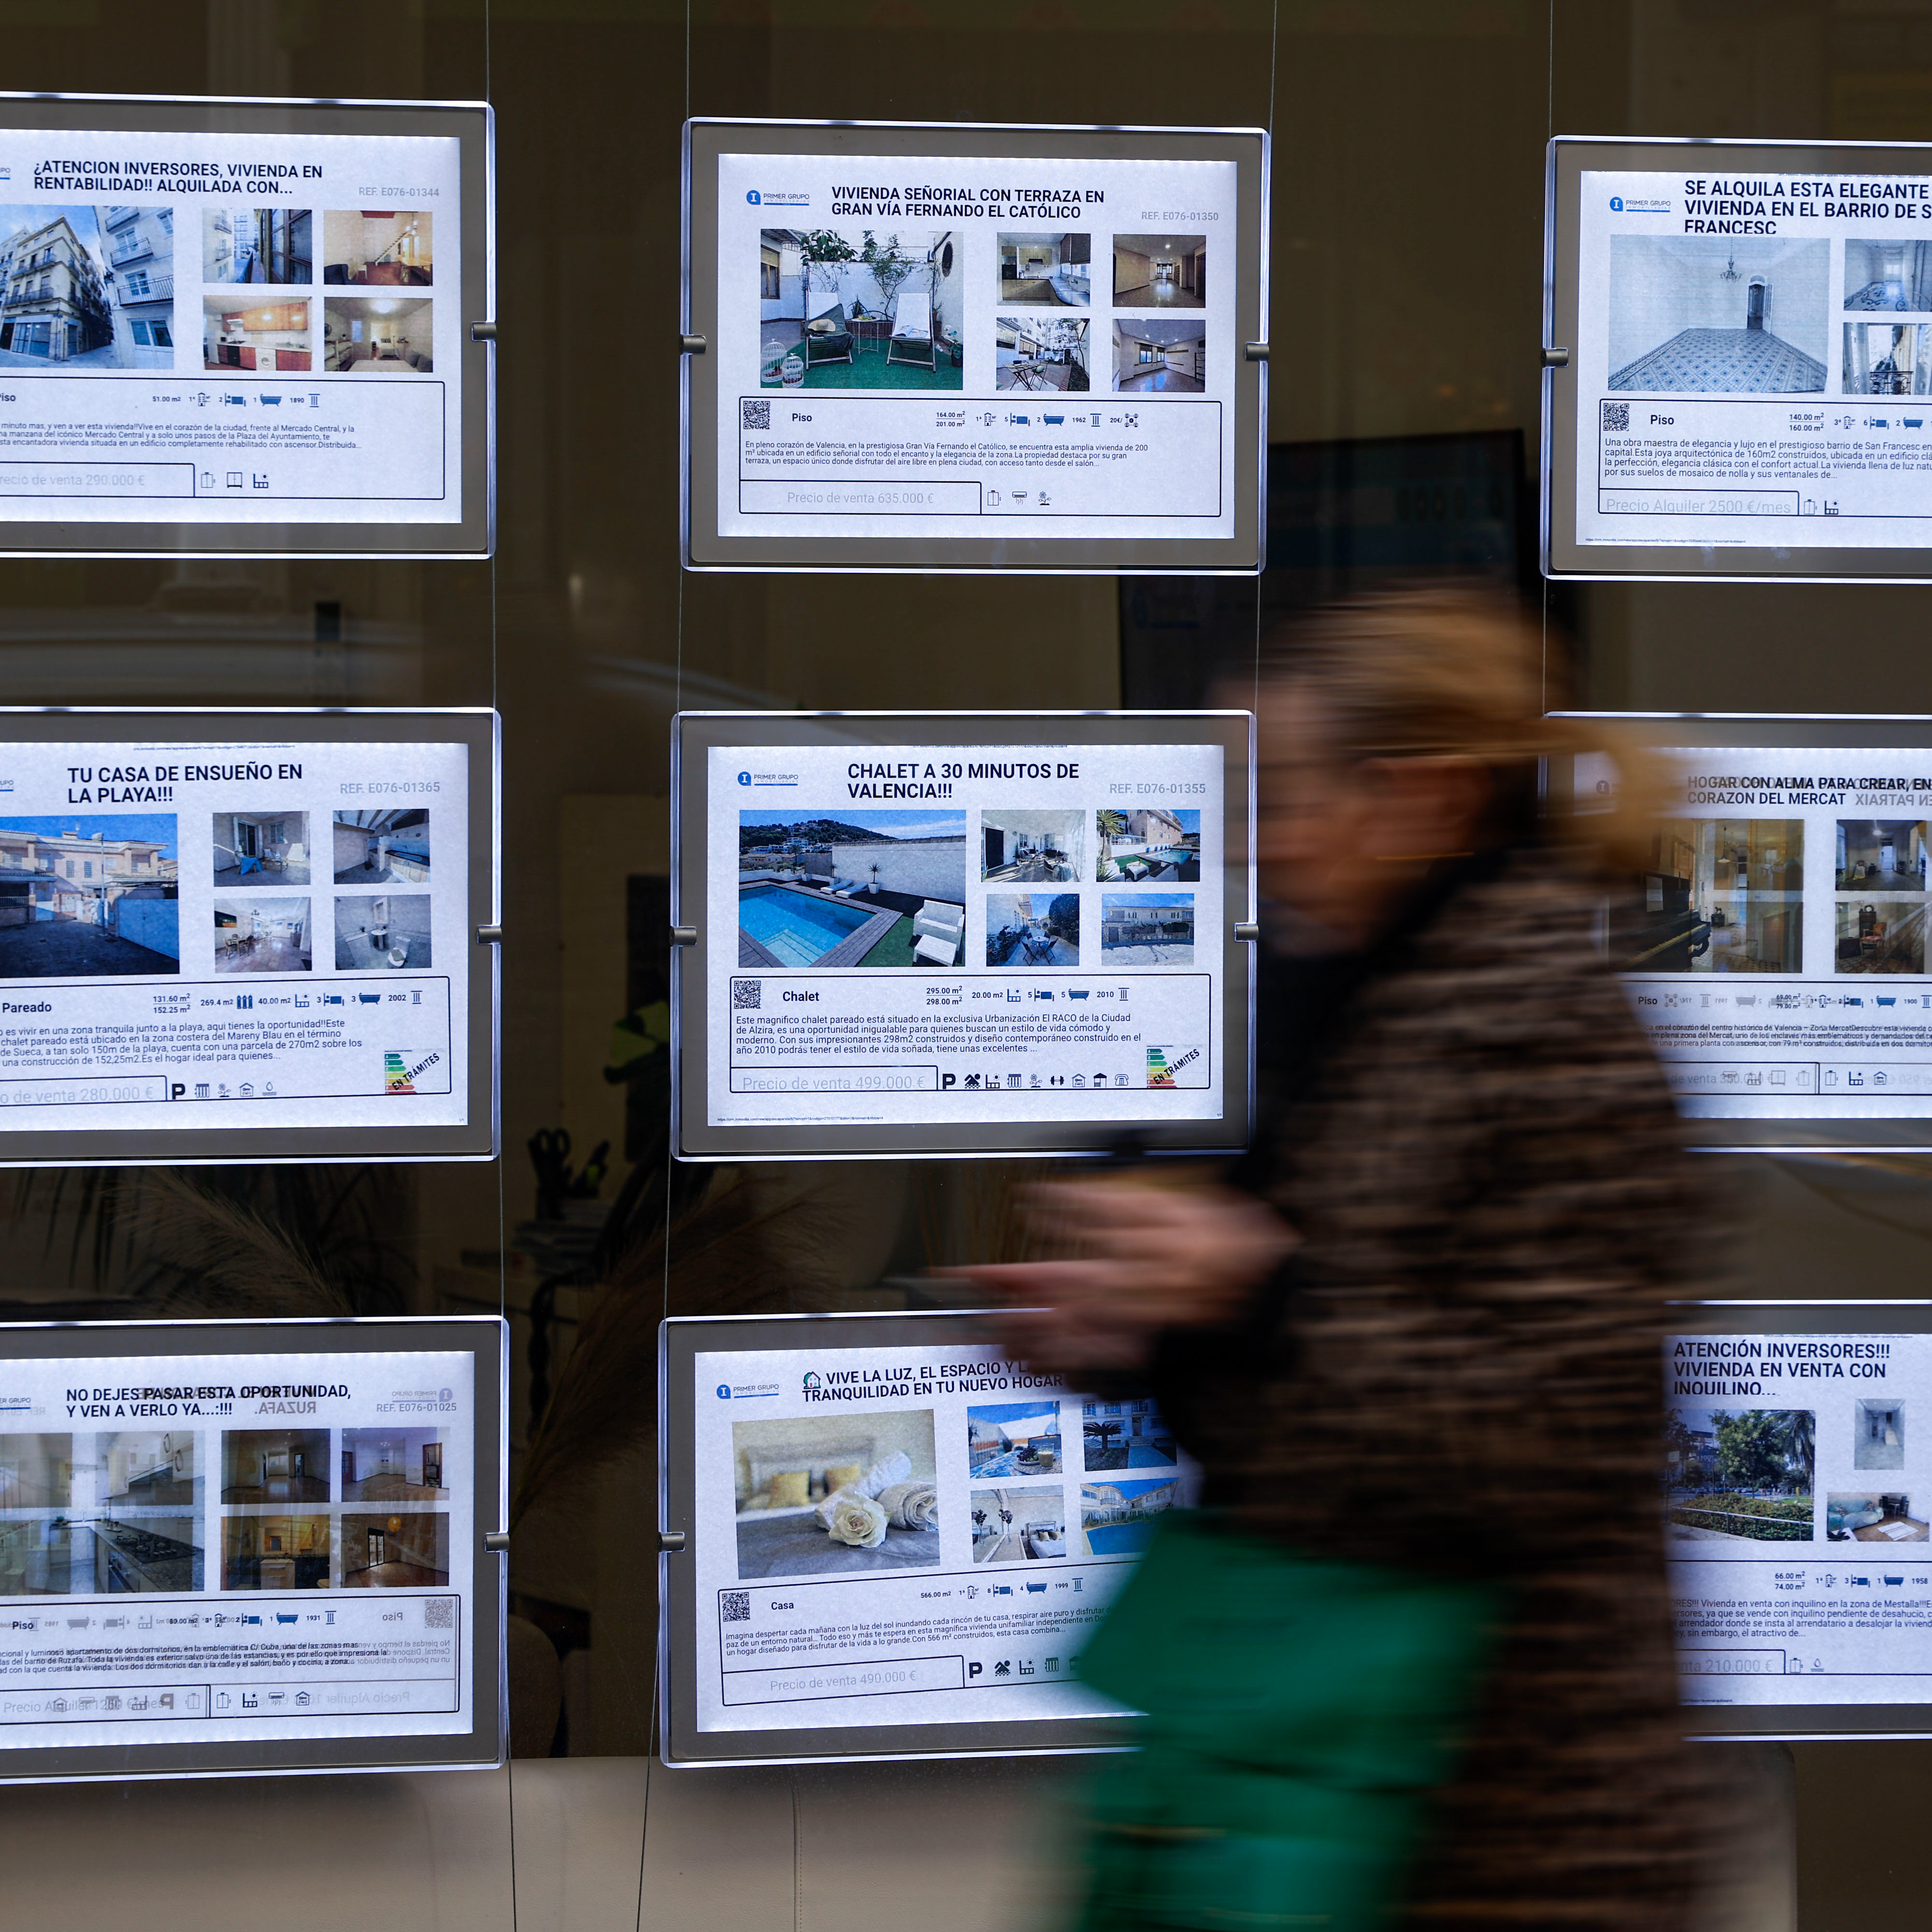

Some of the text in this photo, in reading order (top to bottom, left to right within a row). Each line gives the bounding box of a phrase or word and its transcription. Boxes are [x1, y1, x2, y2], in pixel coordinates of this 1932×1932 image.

[125, 162, 223, 179] INVERSORES,
[227, 164, 298, 178] VIVIENDA
[303, 165, 322, 178] EN
[34, 176, 292, 194] RENTABILIDAD!! ALQUILADA CON...
[359, 187, 440, 197] REF. E076-01344
[1685, 180, 1929, 199] SE ALQUILA ESTA ELEGANTE
[831, 185, 1104, 203] VIVIENDA SEÑORIAL CON TERRAZA EN
[832, 200, 1081, 218] GRAN VÍA FERNANDO EL CATÓLICO
[1684, 199, 1917, 218] VIVIENDA EN EL BARRIO DE
[1141, 212, 1219, 221] REF. E076-01350
[1685, 219, 1776, 234] FRANCESC
[792, 413, 812, 422] Piso
[1650, 414, 1674, 425] Piso
[1605, 469, 1619, 478] por
[1637, 468, 1664, 476] suelos
[1666, 468, 1677, 477] de
[1679, 469, 1714, 477] mosaico
[1716, 469, 1727, 477] de
[1728, 469, 1748, 478] nolla
[1750, 471, 1755, 480] y
[1774, 470, 1818, 479] ventanales
[788, 492, 934, 504] Precio de venta 635.000 €
[67, 761, 302, 783] TU CASA DE ENSUEÑO EN
[848, 763, 1079, 779] CHALET A 30 MINUTOS DE
[340, 781, 441, 794] REF. E076-01365
[847, 783, 952, 798] VALENCIA!!!
[1109, 783, 1206, 794] REF. E076-01355
[1688, 776, 1737, 789] HOGAR
[1741, 777, 1771, 789] CON
[1775, 777, 1814, 789] ALMA
[1818, 778, 1855, 789] PARA
[1860, 778, 1909, 792] CREAR,
[68, 786, 173, 803] LA PLAYA!!!
[1687, 792, 1847, 805] CORAZON DEL MERCAT
[782, 991, 820, 1002] Chalet
[2, 1001, 52, 1013] Pareado
[736, 1046, 752, 1054] año
[754, 1046, 776, 1054] 2010
[778, 1045, 808, 1055] podrás
[834, 1045, 841, 1053] el
[843, 1045, 867, 1053] estilo
[869, 1045, 880, 1053] de
[881, 1044, 899, 1053] vida
[901, 1044, 935, 1054] soñada,
[936, 1044, 958, 1052] tiene
[982, 1044, 1028, 1052] excelentes
[1153, 1049, 1200, 1084] EN TRÁMITES
[743, 1076, 924, 1090] Precio de venta 499.000 €
[1674, 1340, 1890, 1359] ATENCIÓN INVERSORES!!!
[826, 1361, 1013, 1385] VIVE LA LUZ, EL ESPACIO Y
[1674, 1362, 1886, 1378] VIVIENDA EN VENTA CON
[67, 1385, 351, 1401] NO DEJES PASAR ESTA OPORTUNIDAD,
[802, 1375, 1063, 1402] TRANQUILIDAD EN TU NUEVO HOGAR
[66, 1405, 76, 1418] Y
[80, 1405, 110, 1418] VEN
[114, 1405, 126, 1417] A
[129, 1403, 178, 1417] VERLO
[376, 1402, 457, 1412] REF. E076-01025
[771, 1602, 794, 1610] Casa
[1702, 1629, 1740, 1638] embargo,
[770, 1670, 916, 1691] Precio de venta 490.000 €
